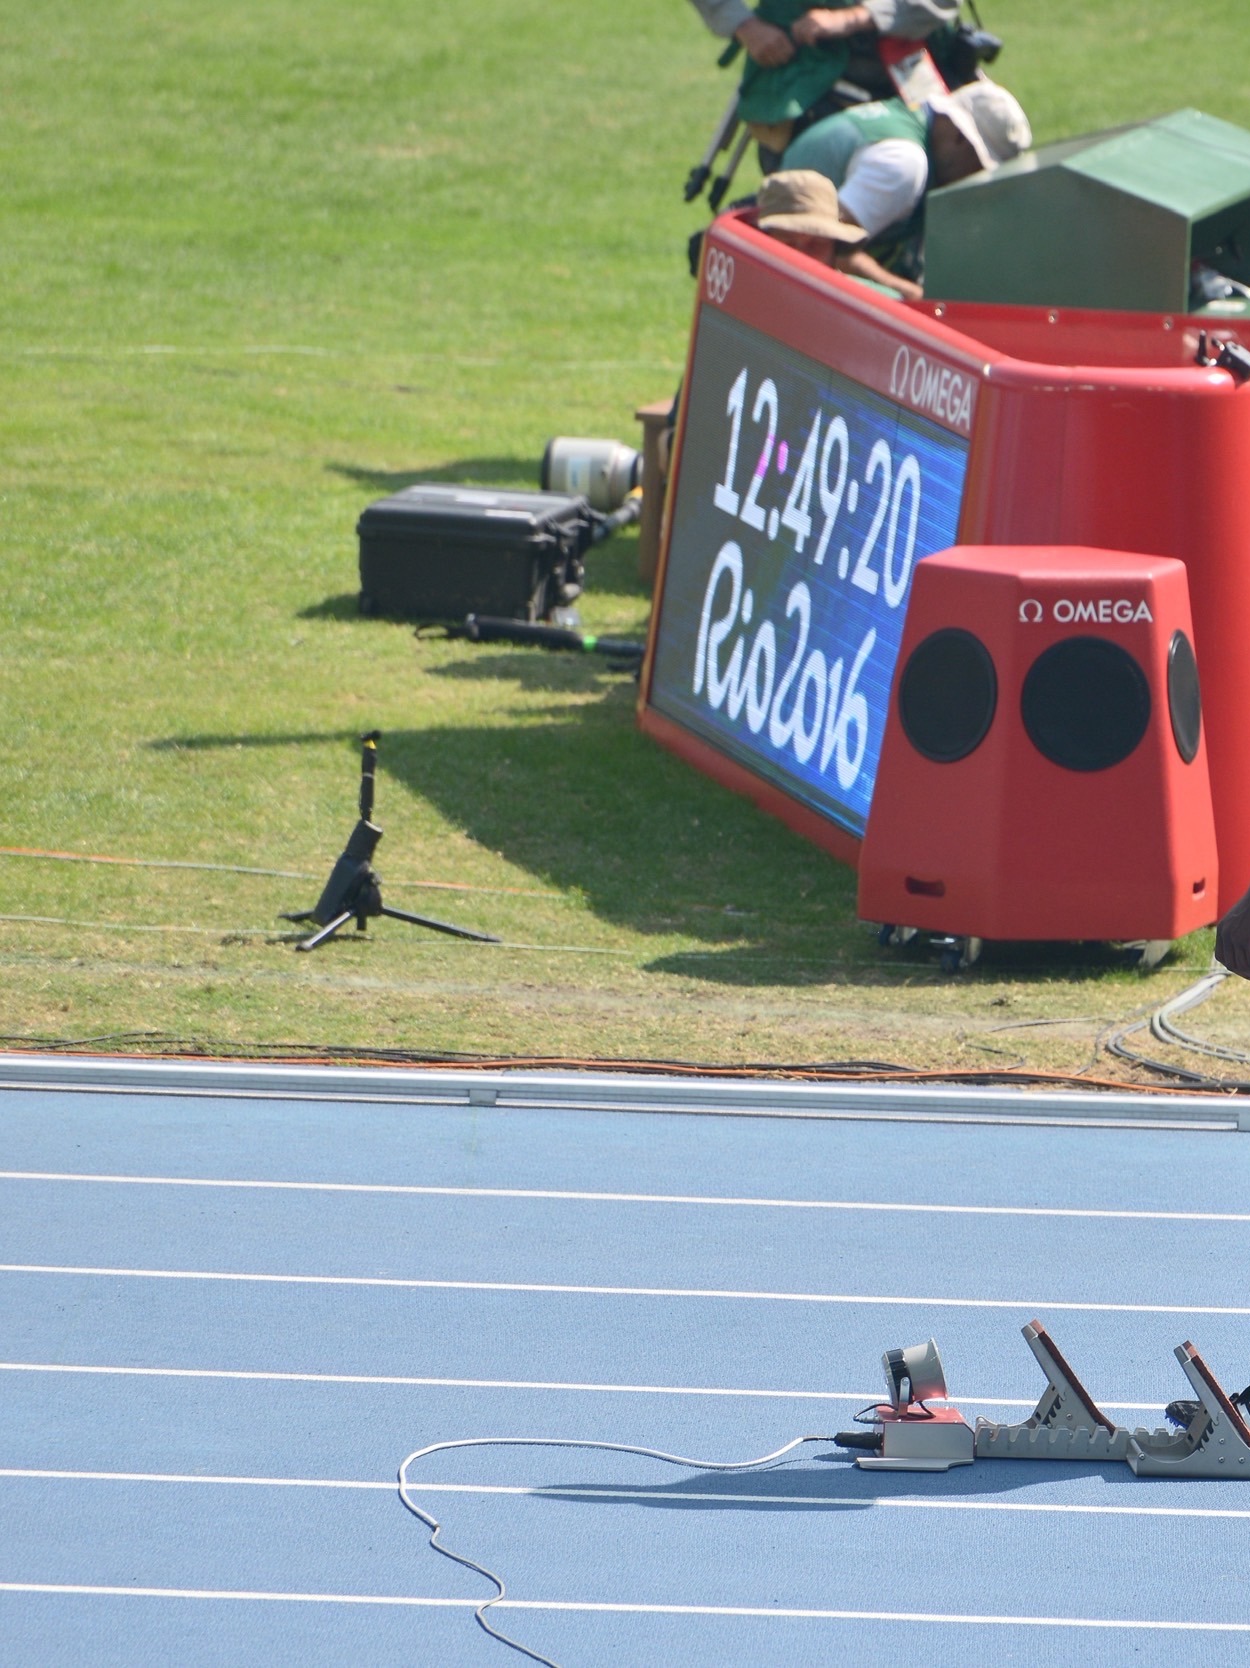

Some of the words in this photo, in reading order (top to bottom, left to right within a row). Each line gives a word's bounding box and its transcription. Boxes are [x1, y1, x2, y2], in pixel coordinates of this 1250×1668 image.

[910, 357, 972, 431] OMEGA
[714, 367, 920, 609] 12:49:20
[693, 541, 876, 790] Rio2016
[1053, 599, 1153, 623] OMEGA
